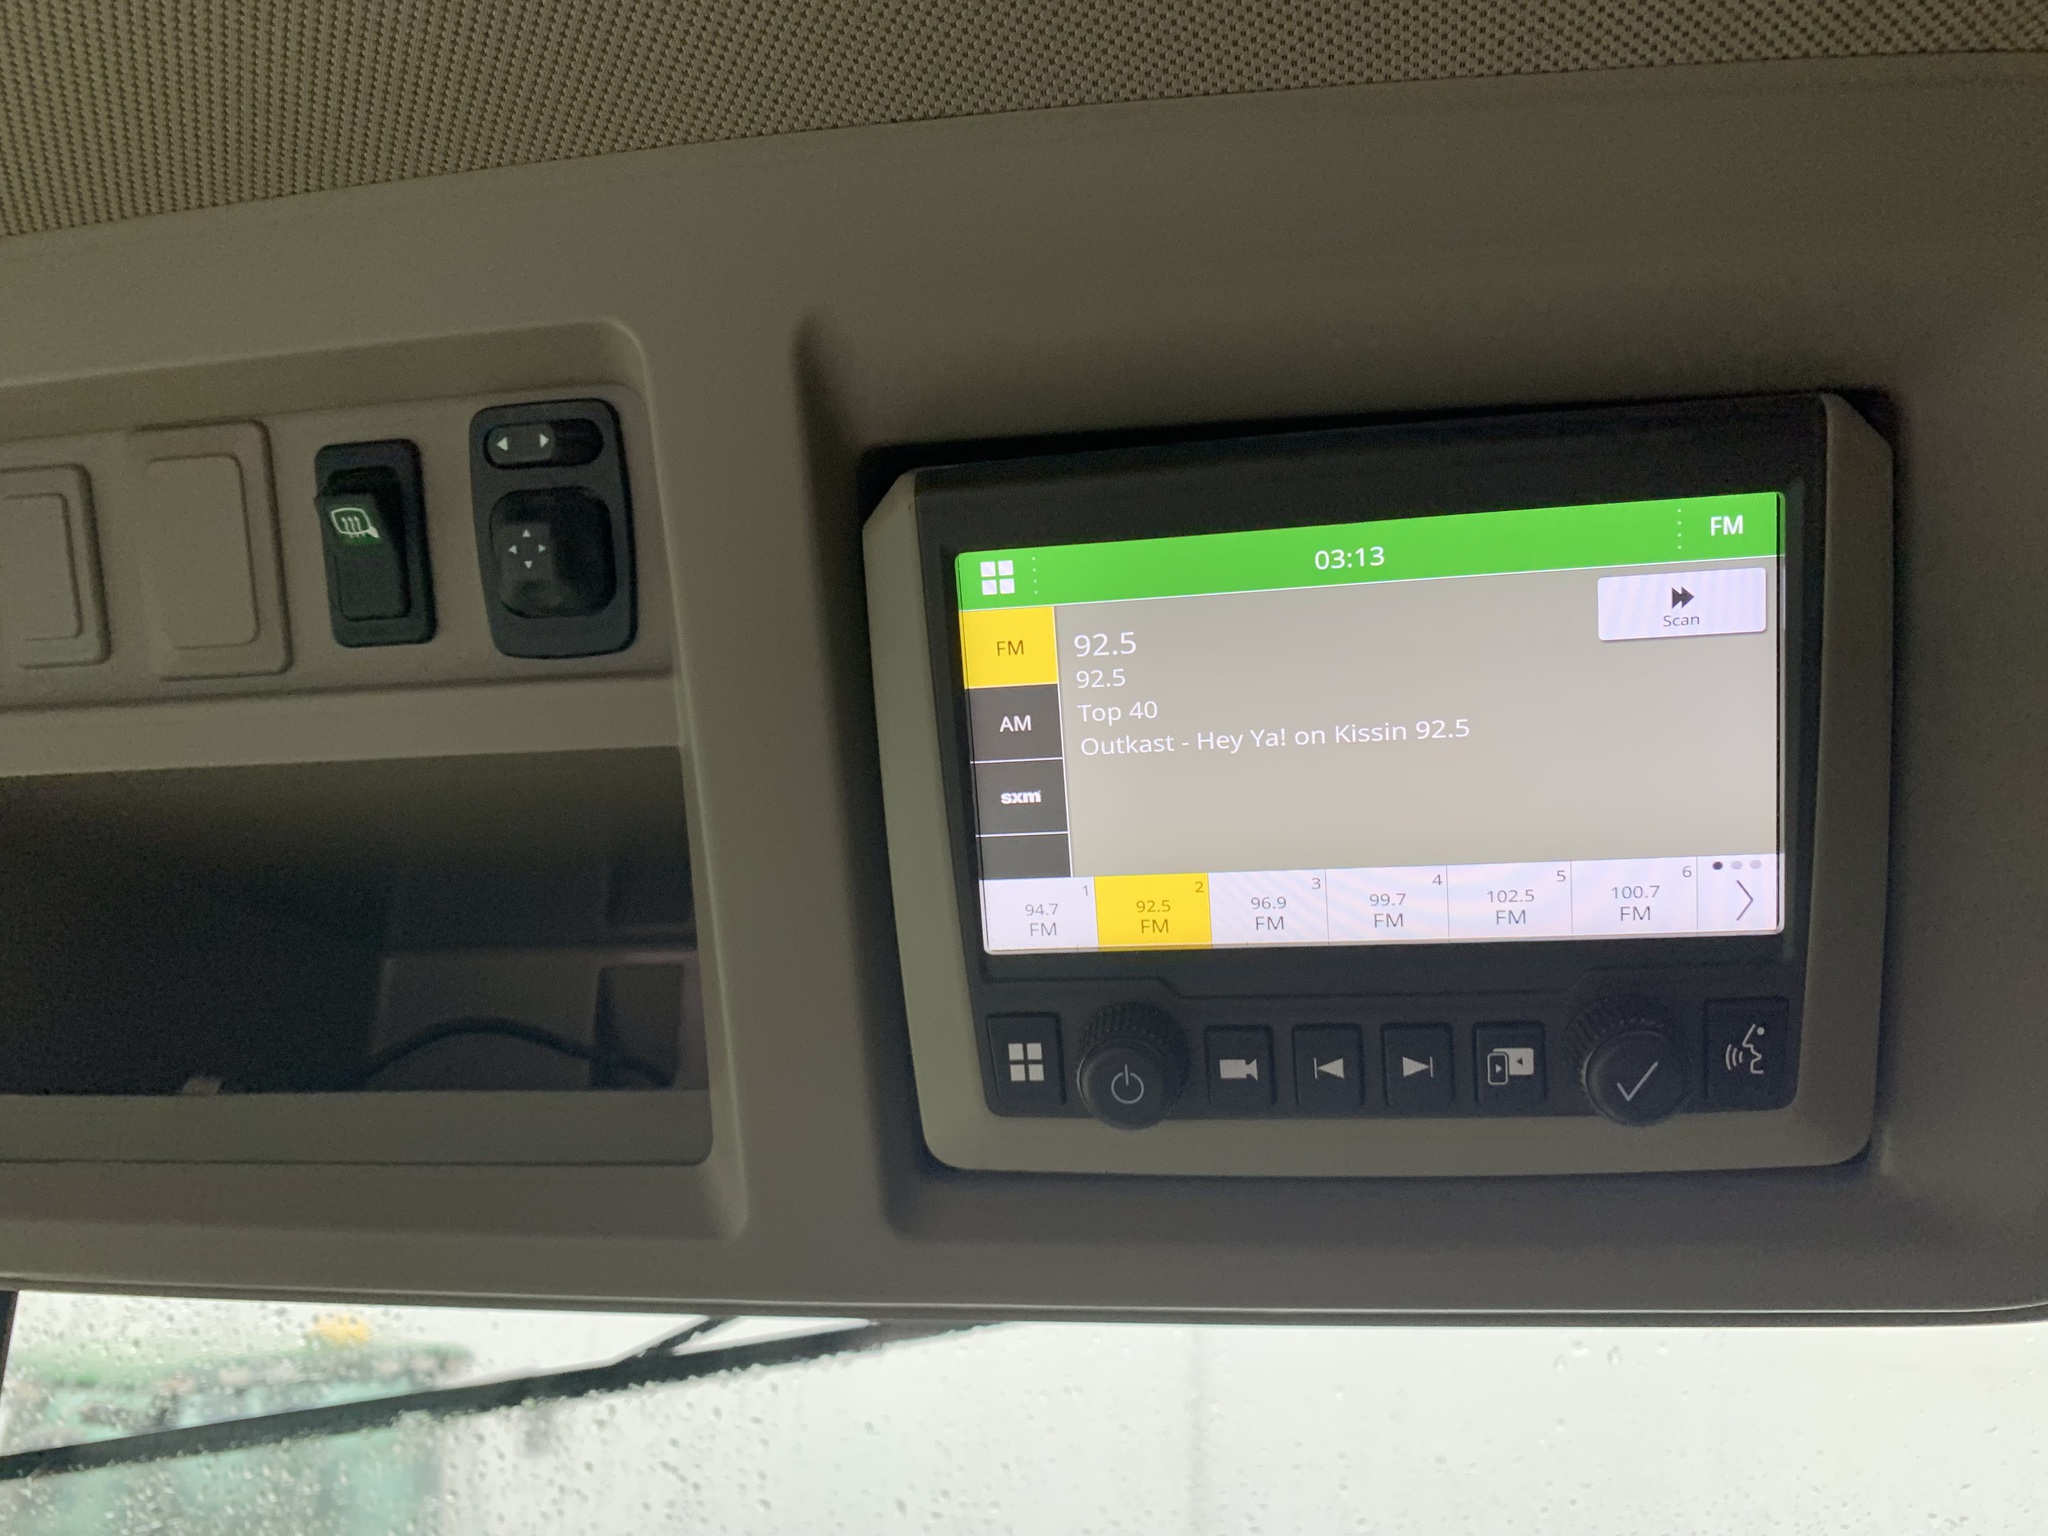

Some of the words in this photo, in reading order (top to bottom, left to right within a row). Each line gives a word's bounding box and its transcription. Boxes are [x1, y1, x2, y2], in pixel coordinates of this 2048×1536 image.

[1709, 514, 1744, 537] FM
[1314, 546, 1386, 571] 03:13
[1662, 612, 1700, 628] Scan
[996, 639, 1025, 657] FM
[1073, 631, 1137, 658] 92.5
[1075, 668, 1126, 689] 92.5
[1077, 703, 1122, 727] Top
[1129, 700, 1158, 720] 40
[999, 714, 1032, 733] AM
[1080, 734, 1175, 756] Outkast
[1197, 730, 1243, 756] Hey
[1249, 727, 1287, 748] Ya!
[1294, 729, 1326, 746] on
[1335, 721, 1407, 744] Kissin
[1415, 718, 1470, 740] 92.5
[1000, 790, 1042, 805] sxm
[1431, 873, 1443, 886] 4
[1556, 869, 1567, 882] 5
[1681, 865, 1693, 878] 6
[1082, 884, 1089, 897] 1
[1194, 880, 1205, 894] 2
[1310, 876, 1322, 890] 3
[1368, 892, 1407, 907] 99.7
[1486, 888, 1535, 904] 102.5
[1611, 884, 1660, 900] 100.7
[1024, 902, 1059, 917] 94.7
[1135, 899, 1171, 914] 92.5
[1250, 895, 1287, 910] 96.9
[1373, 912, 1404, 928] FM
[1495, 909, 1527, 925] FM
[1619, 905, 1652, 922] FM
[1029, 921, 1058, 937] FM
[1140, 918, 1170, 934] FM
[1255, 915, 1285, 931] FM
